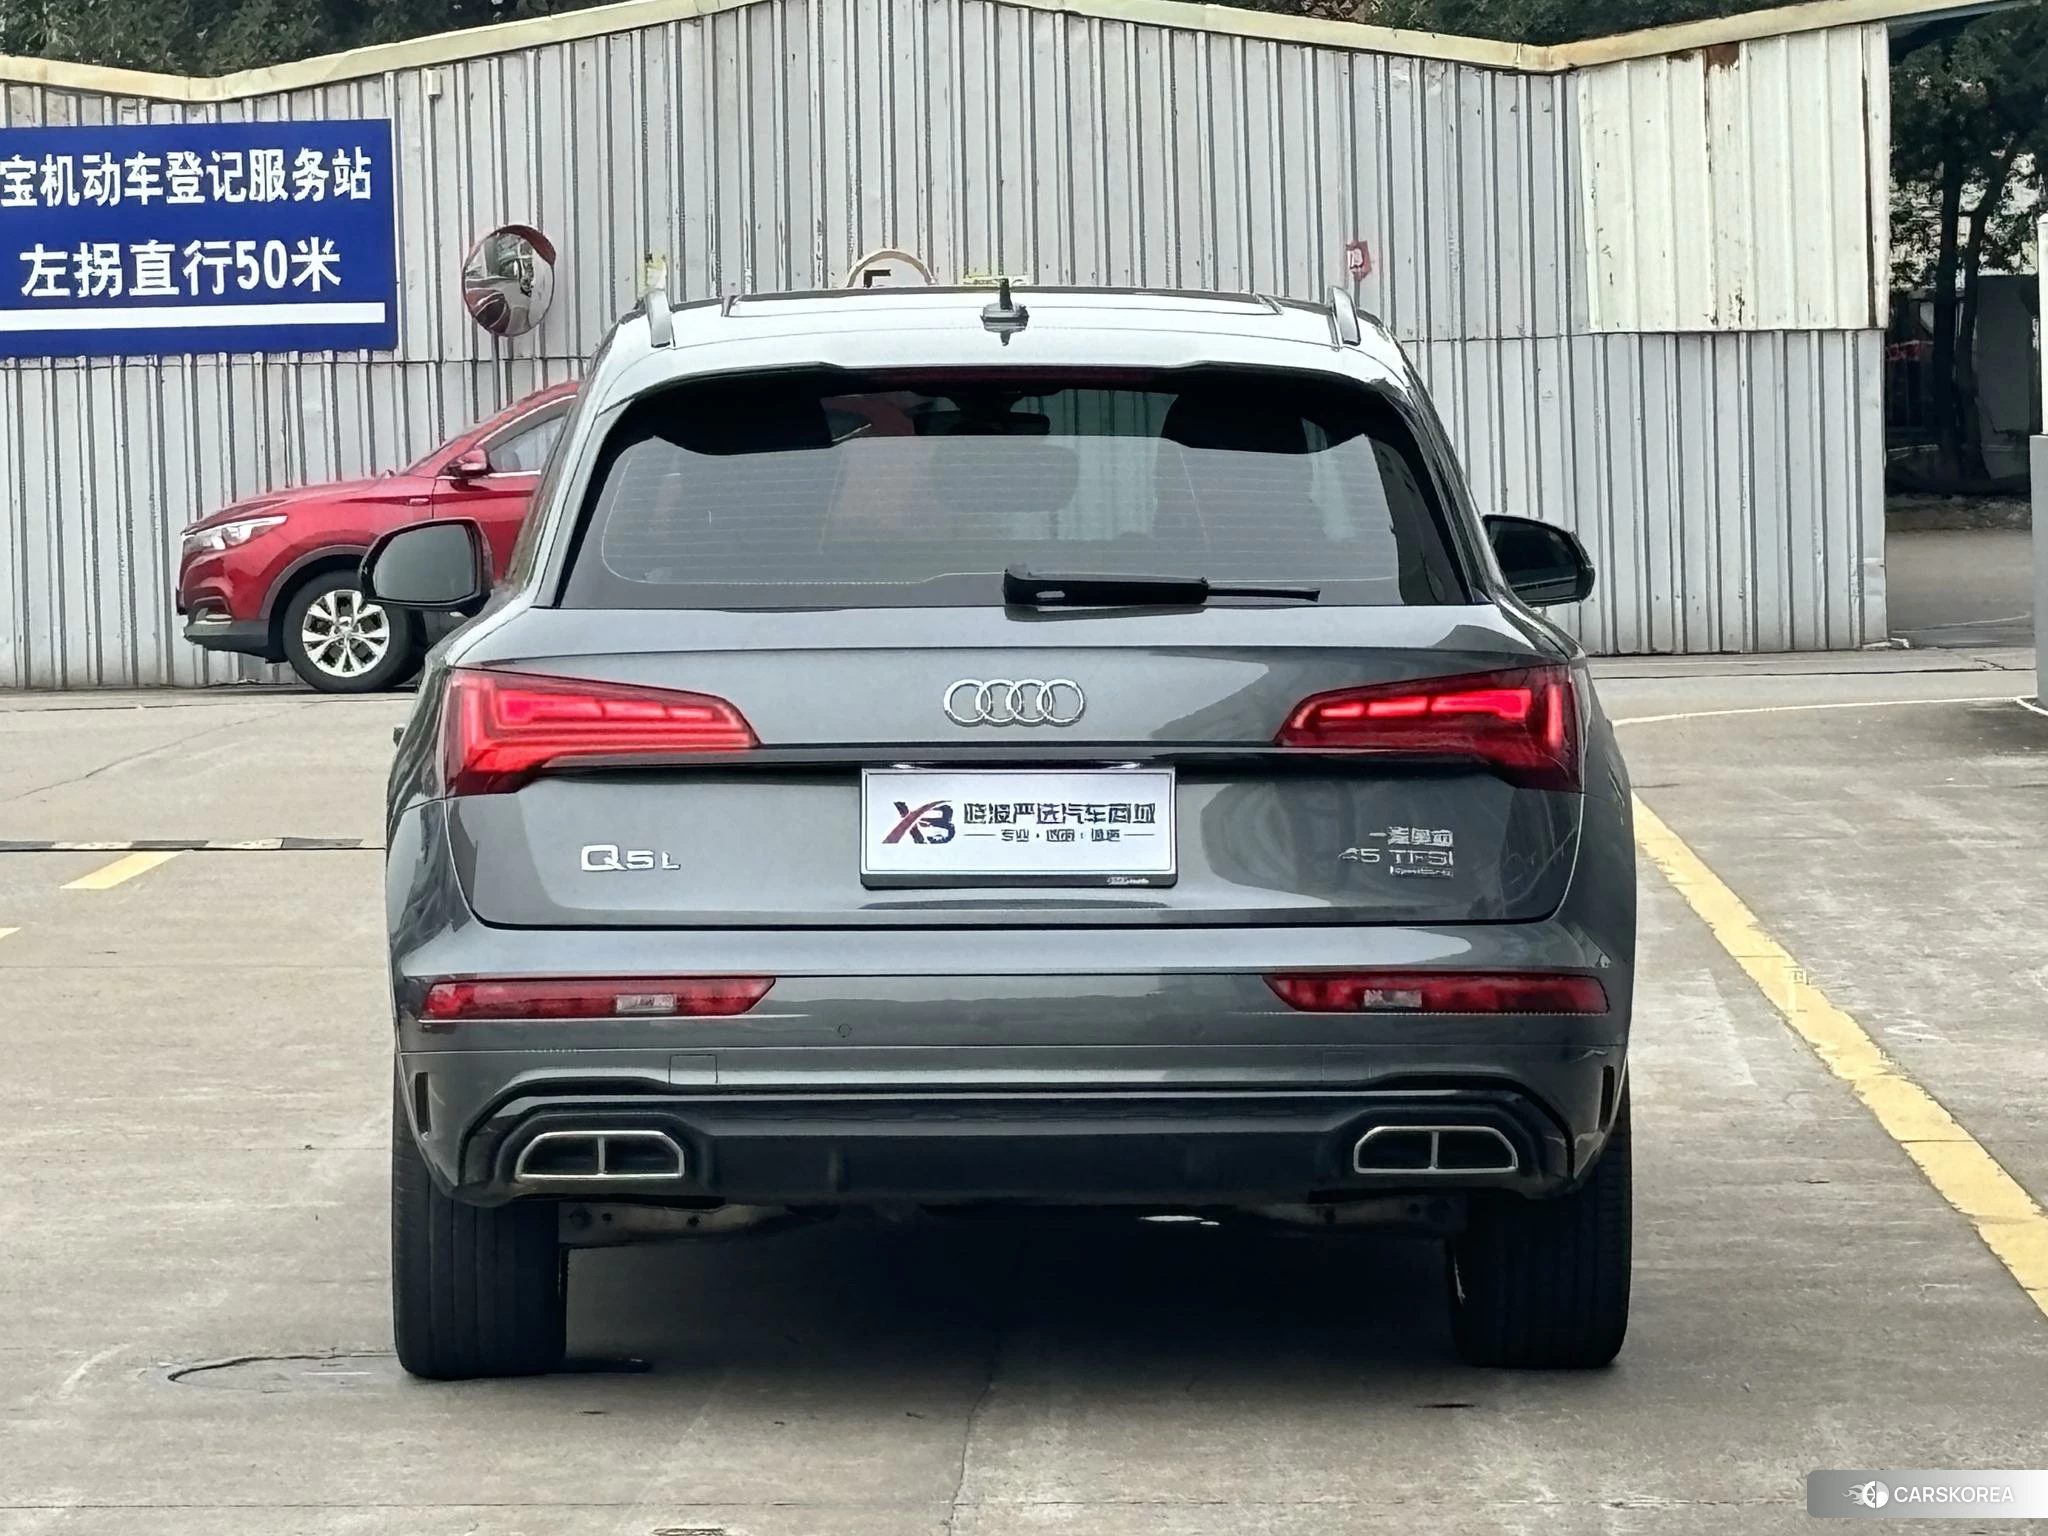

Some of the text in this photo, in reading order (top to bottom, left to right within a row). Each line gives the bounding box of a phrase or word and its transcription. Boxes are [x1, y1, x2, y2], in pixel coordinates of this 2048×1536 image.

[0, 146, 372, 208] 宝机动车登记服务站
[19, 236, 342, 298] 左拐直行50米
